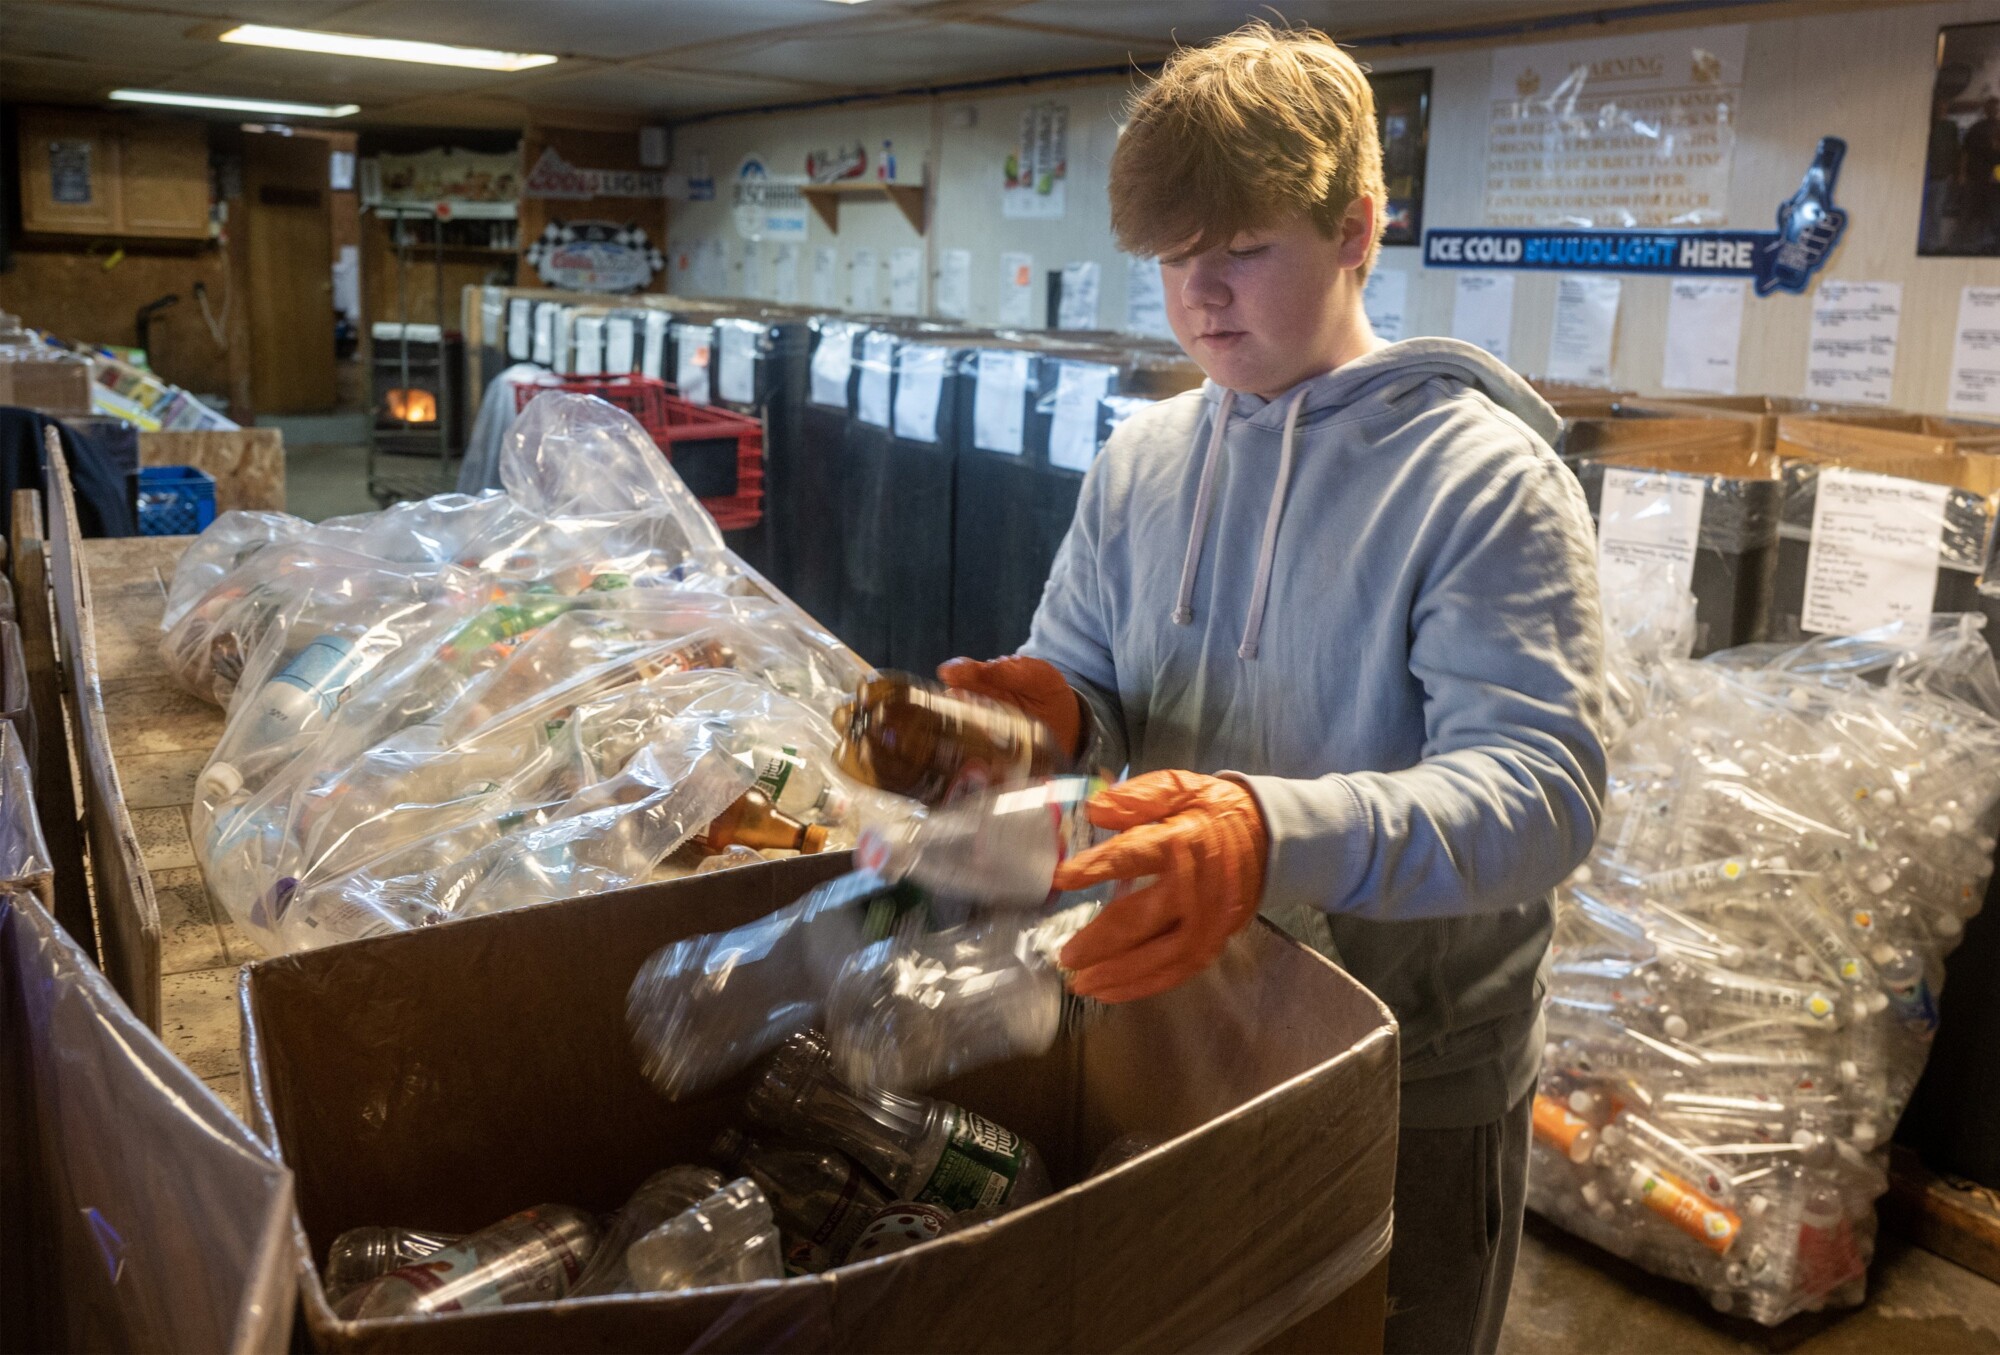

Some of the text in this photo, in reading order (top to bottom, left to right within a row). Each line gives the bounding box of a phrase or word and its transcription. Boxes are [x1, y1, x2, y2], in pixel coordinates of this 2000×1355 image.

[1430, 237, 1754, 269] ICE COLD BUUUDLIGHT HERE
